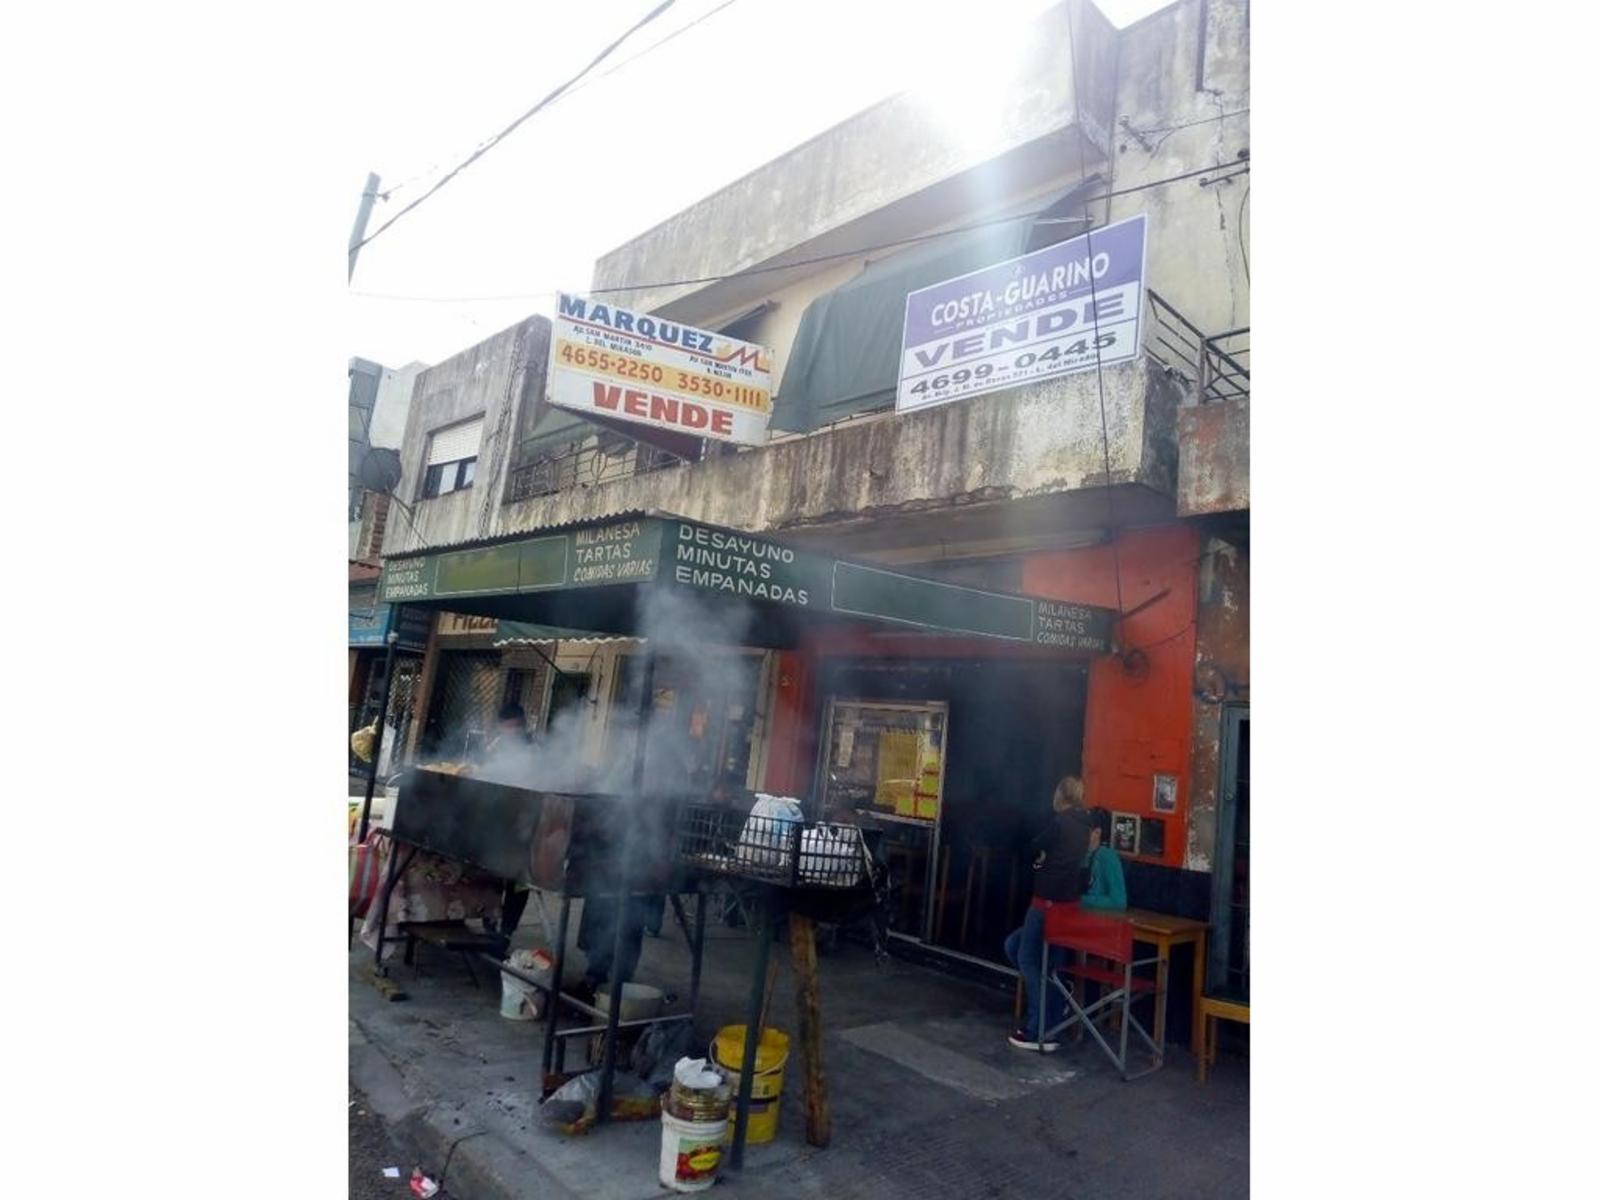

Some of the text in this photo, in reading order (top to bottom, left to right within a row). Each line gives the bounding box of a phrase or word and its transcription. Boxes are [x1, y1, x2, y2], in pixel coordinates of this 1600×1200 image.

[559, 294, 713, 353] MARQUEZ
[915, 293, 1124, 368] VENDE
[593, 382, 734, 435] VENDE
[575, 522, 640, 546] MILANESA
[575, 543, 632, 563] TARTAS
[679, 524, 795, 563] DESAYUNO
[677, 544, 772, 579] MINUTAS
[675, 565, 809, 605] EMPANADAS
[1038, 615, 1085, 634] TARTAS
